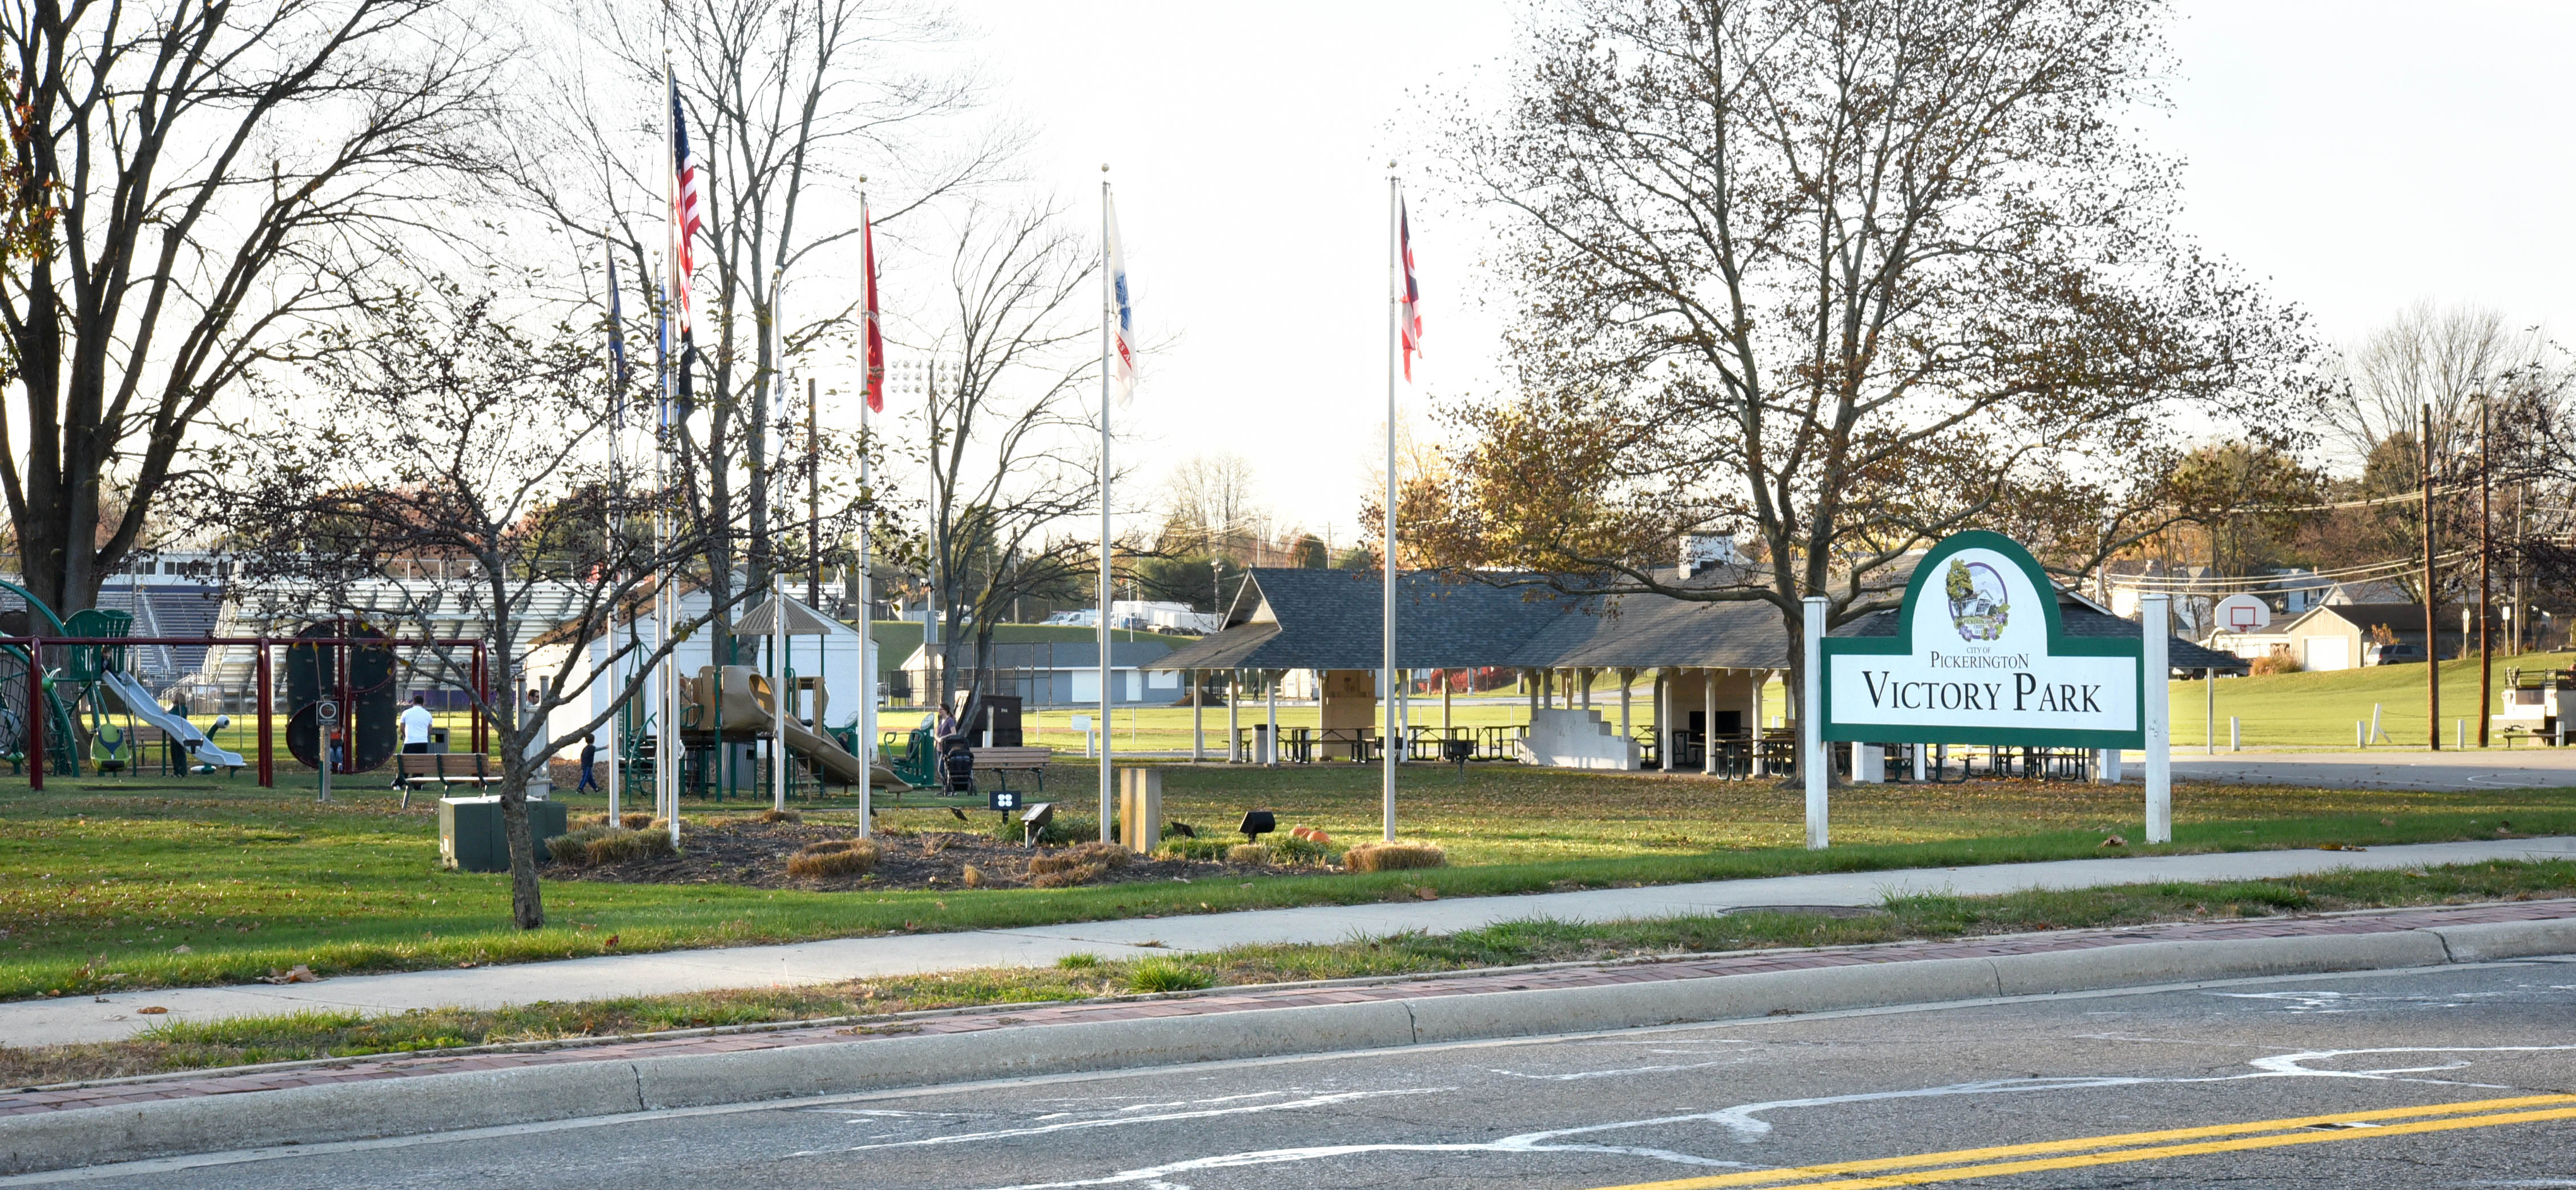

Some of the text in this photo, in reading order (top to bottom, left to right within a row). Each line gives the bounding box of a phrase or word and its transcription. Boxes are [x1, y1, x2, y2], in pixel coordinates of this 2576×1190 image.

[1931, 650, 2028, 669] PICKERINGTON
[1862, 671, 2102, 713] VICTORY PARK
